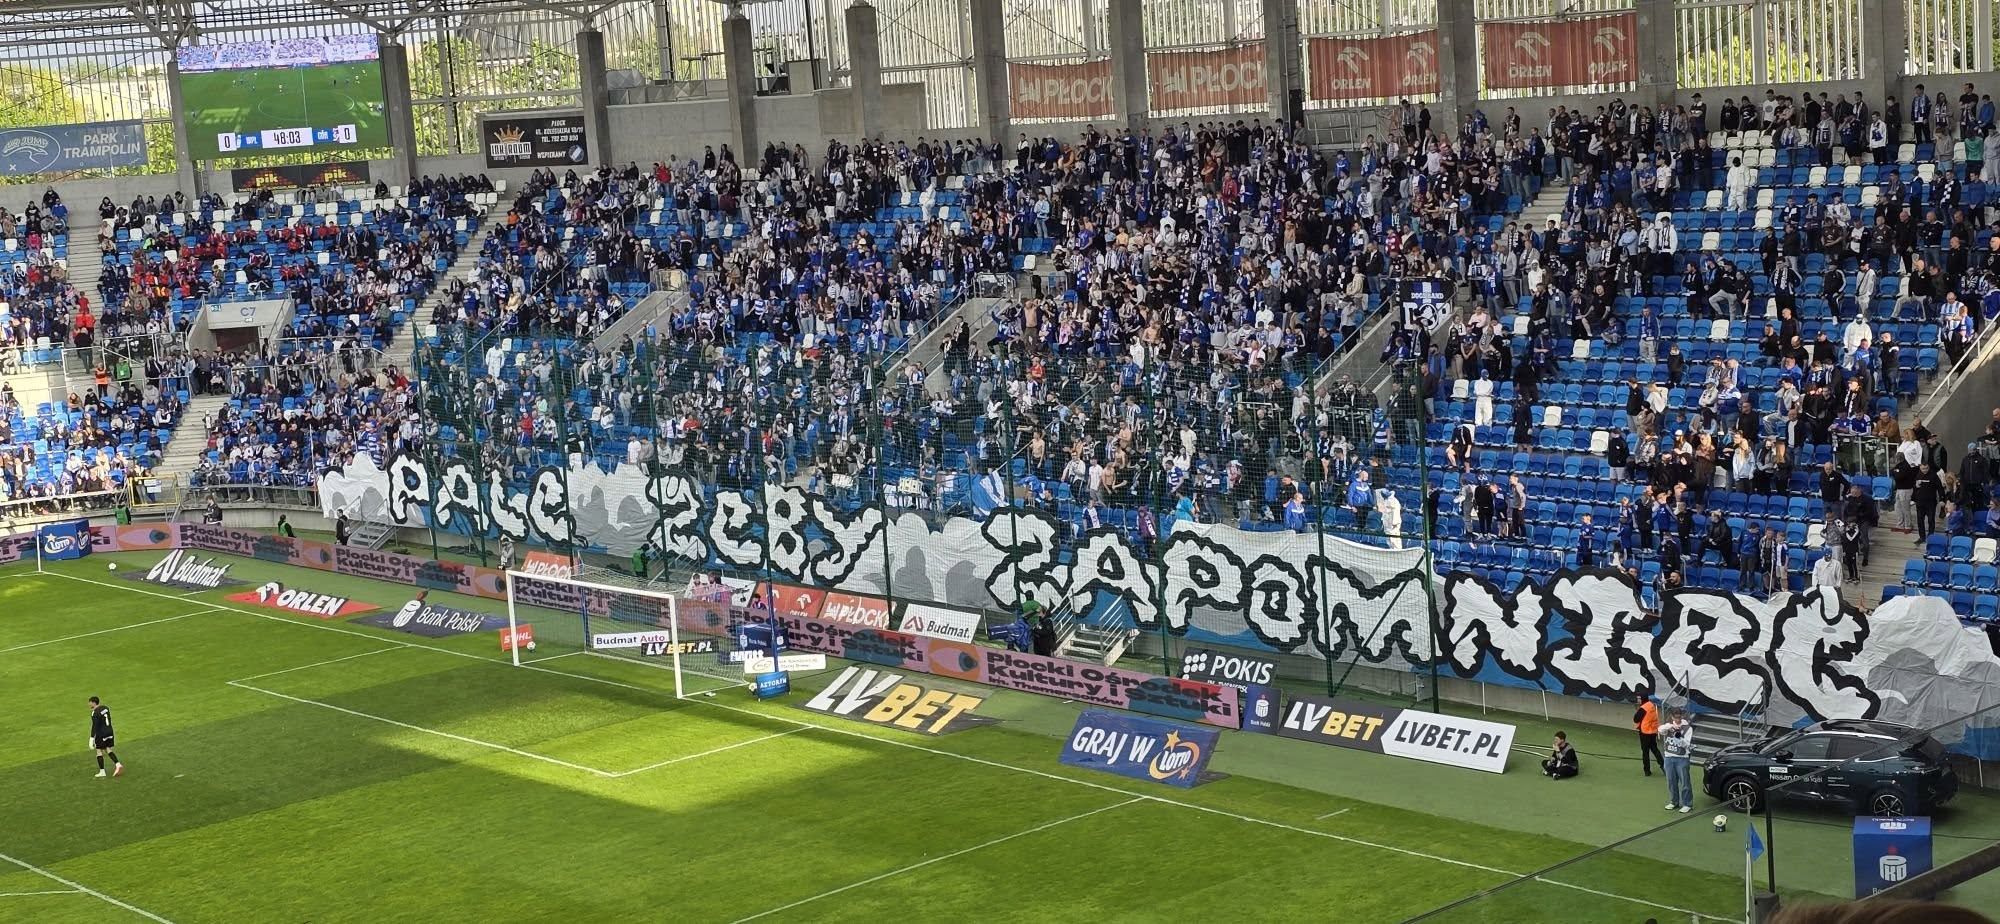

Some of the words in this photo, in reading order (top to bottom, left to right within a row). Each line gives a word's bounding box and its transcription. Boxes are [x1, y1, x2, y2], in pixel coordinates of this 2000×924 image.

[1509, 64, 1551, 78] ORLEN
[1331, 77, 1371, 90] ORLEN
[1403, 72, 1437, 87] ORLEN
[83, 133, 117, 146] PARK
[273, 130, 301, 145] 48:03
[344, 127, 351, 141] 0
[224, 135, 231, 149] 0
[63, 142, 140, 159] TRAMPOLIN
[256, 174, 278, 187] pik
[324, 169, 347, 182] pik
[240, 306, 256, 317] C7
[172, 555, 231, 587] Budmat
[336, 557, 401, 577] Kultury
[277, 589, 345, 616] ORLEN
[416, 606, 448, 627] Bank
[445, 612, 485, 632] Polski
[504, 631, 532, 644] SIHL
[596, 636, 637, 645] Budmat
[640, 635, 665, 643] Auto
[1210, 655, 1274, 685] POKIS
[988, 663, 1103, 696] Kultury
[805, 666, 985, 735] LVBET
[1284, 701, 1384, 742] LVBET
[1072, 726, 1129, 765] GRAJ
[1128, 735, 1156, 763] W
[1394, 719, 1502, 759] LVBET.PL
[1159, 750, 1192, 771] LOTTO
[1769, 773, 1793, 781] Nissan
